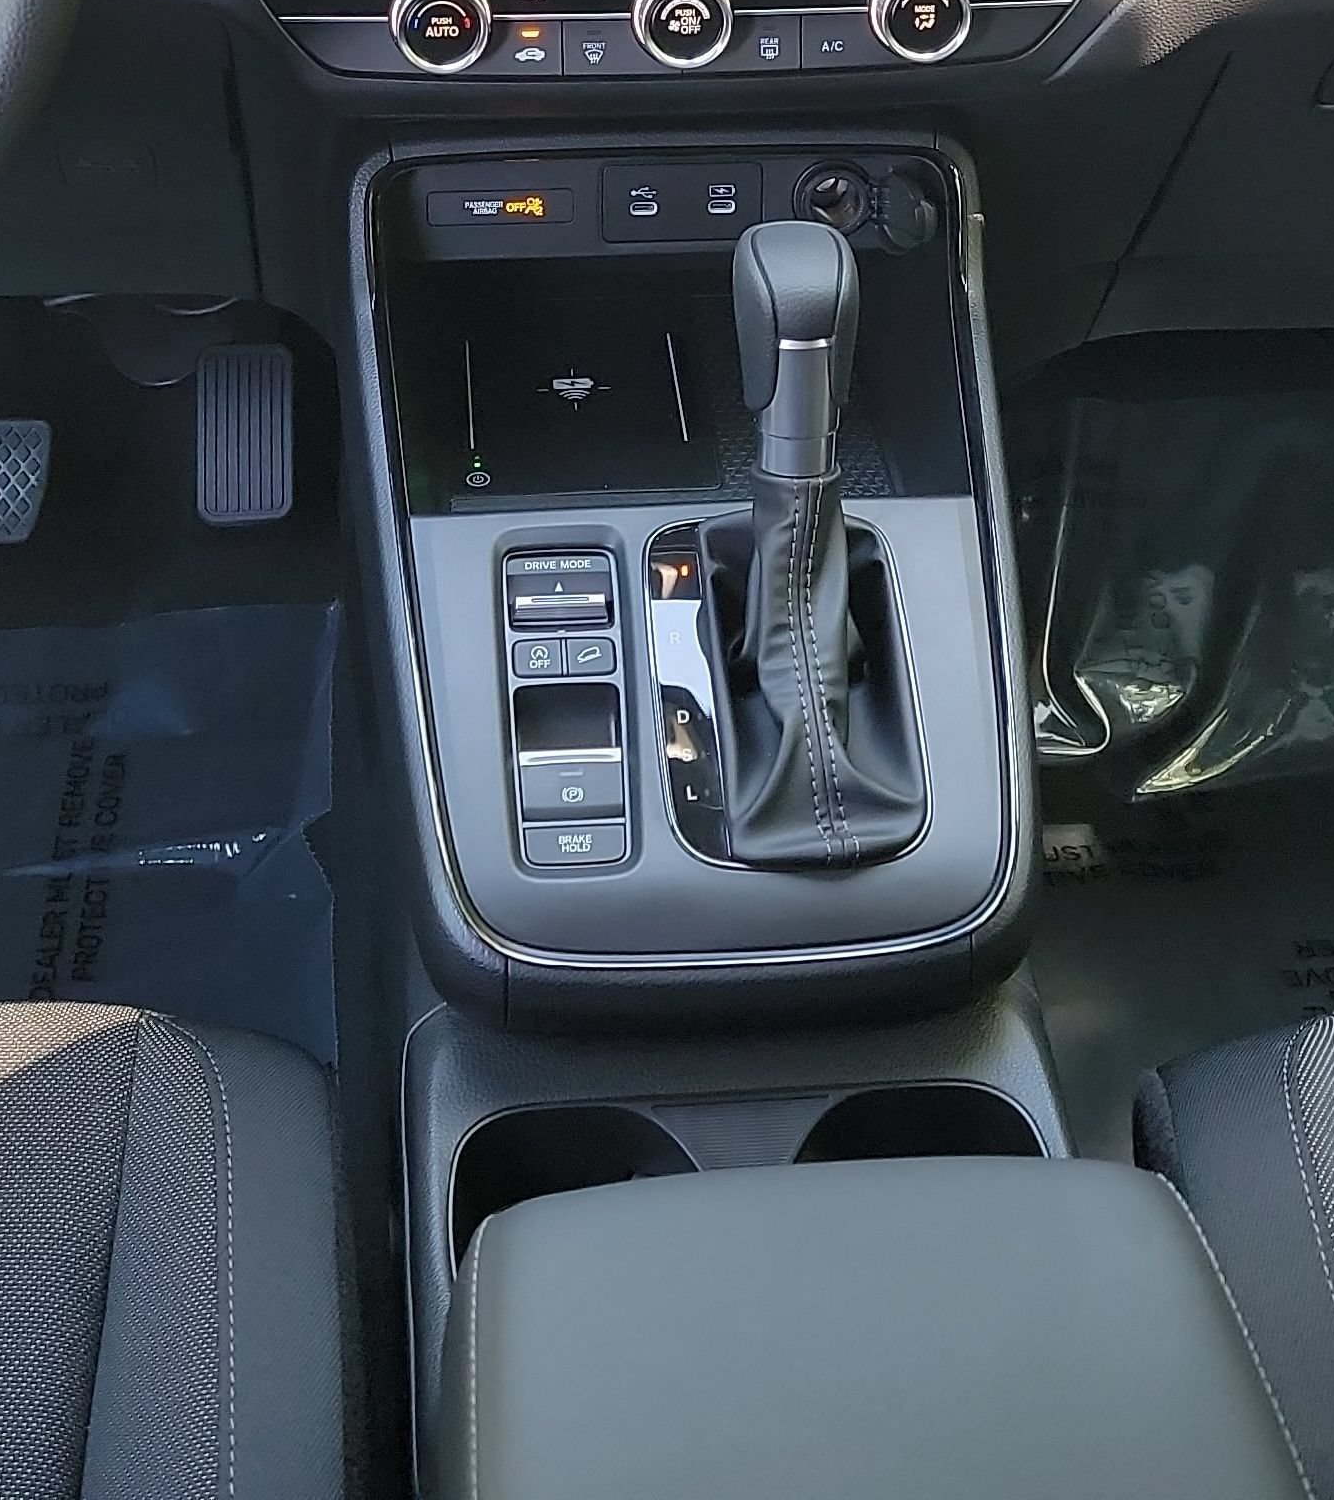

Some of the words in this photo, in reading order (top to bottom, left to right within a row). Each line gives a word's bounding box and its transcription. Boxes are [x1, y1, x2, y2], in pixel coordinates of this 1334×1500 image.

[431, 17, 453, 25] PUSH
[425, 25, 460, 38] AUTO
[681, 25, 701, 35] OFF
[583, 42, 606, 50] FRONT
[822, 41, 844, 52] A/C
[506, 202, 526, 213] OFF
[524, 561, 557, 570] DRIVE
[561, 559, 591, 569] MODE
[670, 632, 681, 643] R
[529, 659, 551, 669] OFF
[676, 709, 690, 724] D
[681, 749, 692, 761] S
[686, 785, 698, 801] L
[559, 834, 592, 845] BRAKE
[562, 844, 591, 853] HOLD
[71, 832, 114, 982] PROTECTE
